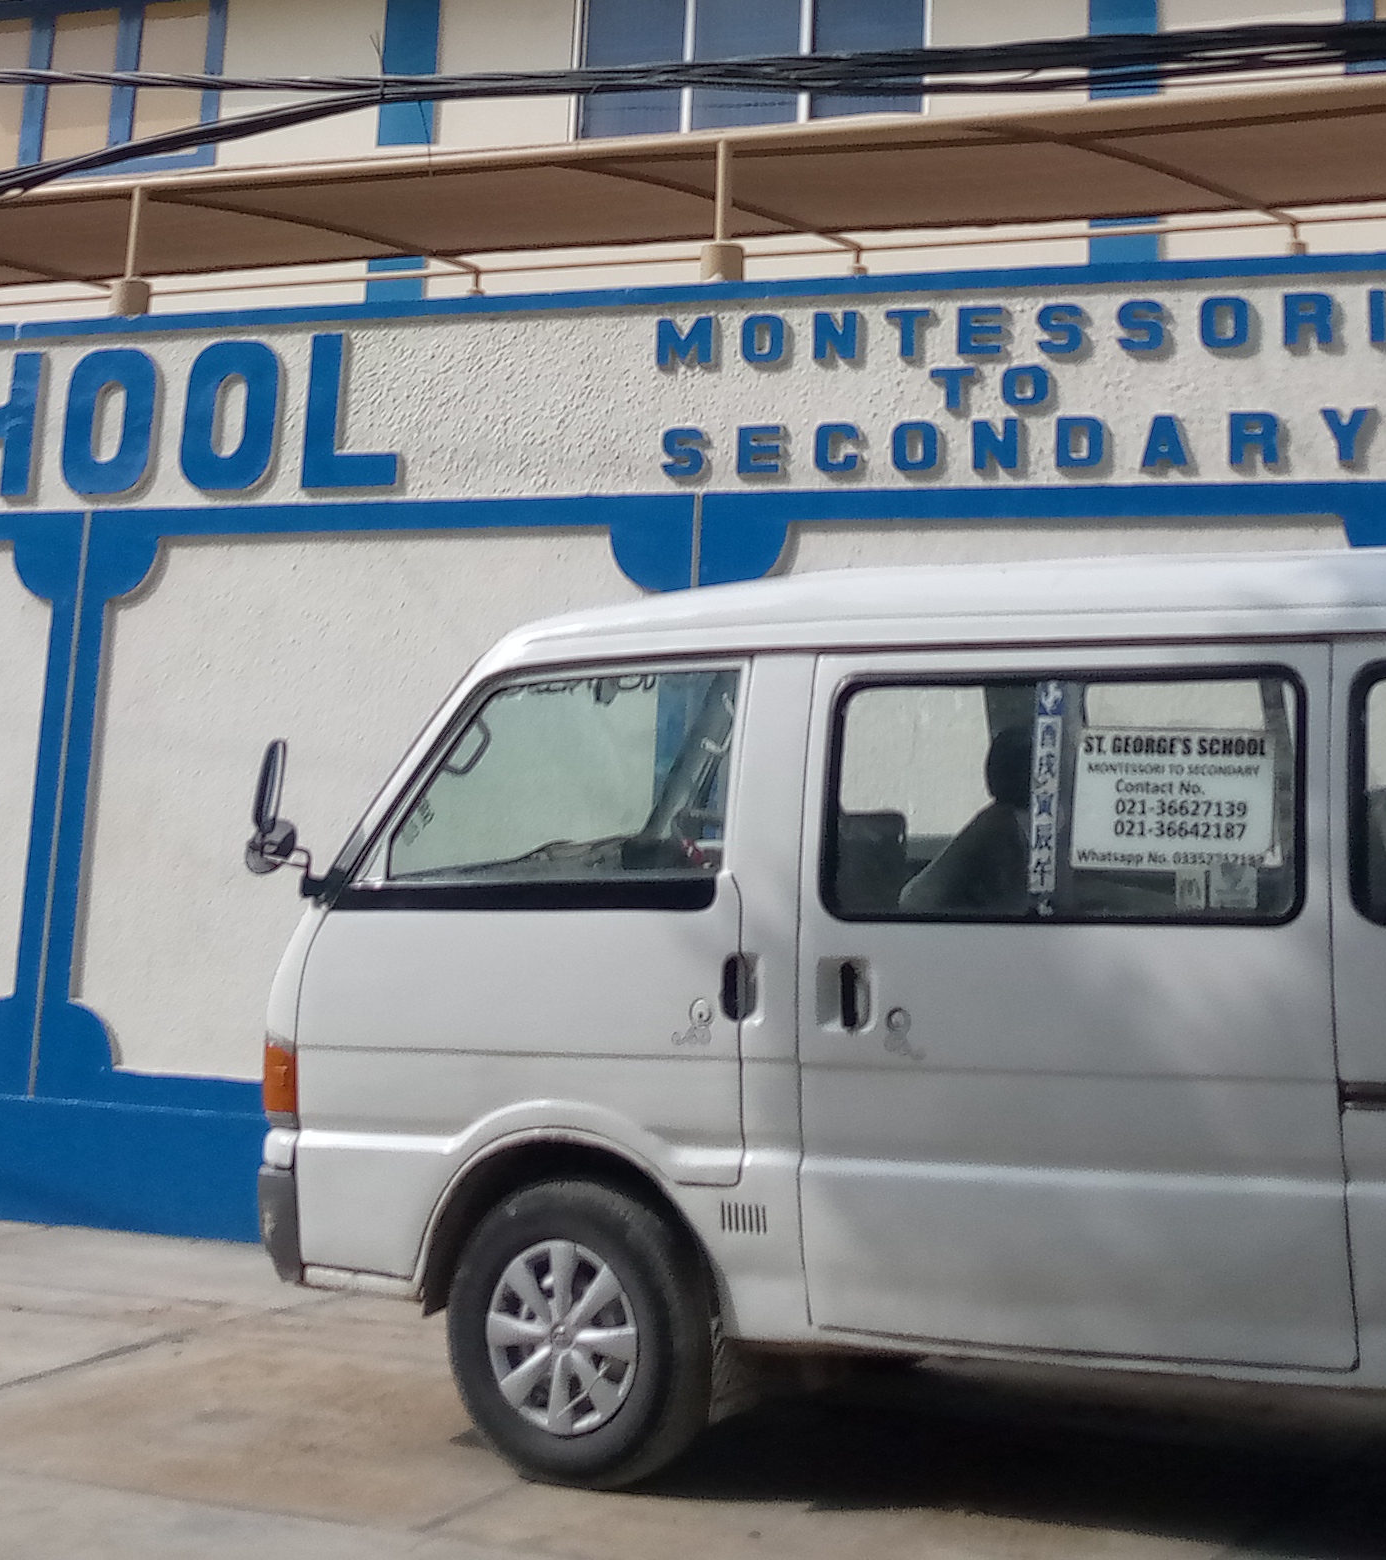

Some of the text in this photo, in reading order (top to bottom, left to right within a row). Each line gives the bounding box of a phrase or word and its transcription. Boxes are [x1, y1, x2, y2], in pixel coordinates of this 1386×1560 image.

[931, 363, 1053, 412] TO
[660, 407, 1376, 480] SECONDARY
[1084, 736, 1267, 756] ST. GEORGE'S SCHOOL
[1087, 762, 1261, 778] MONTESSORI TO SECONDARY
[1115, 778, 1206, 796] Contact No.
[1115, 798, 1248, 818] 021-36627139
[1114, 819, 1248, 840] 021-36642187
[1077, 849, 1143, 865] Whatsapp
